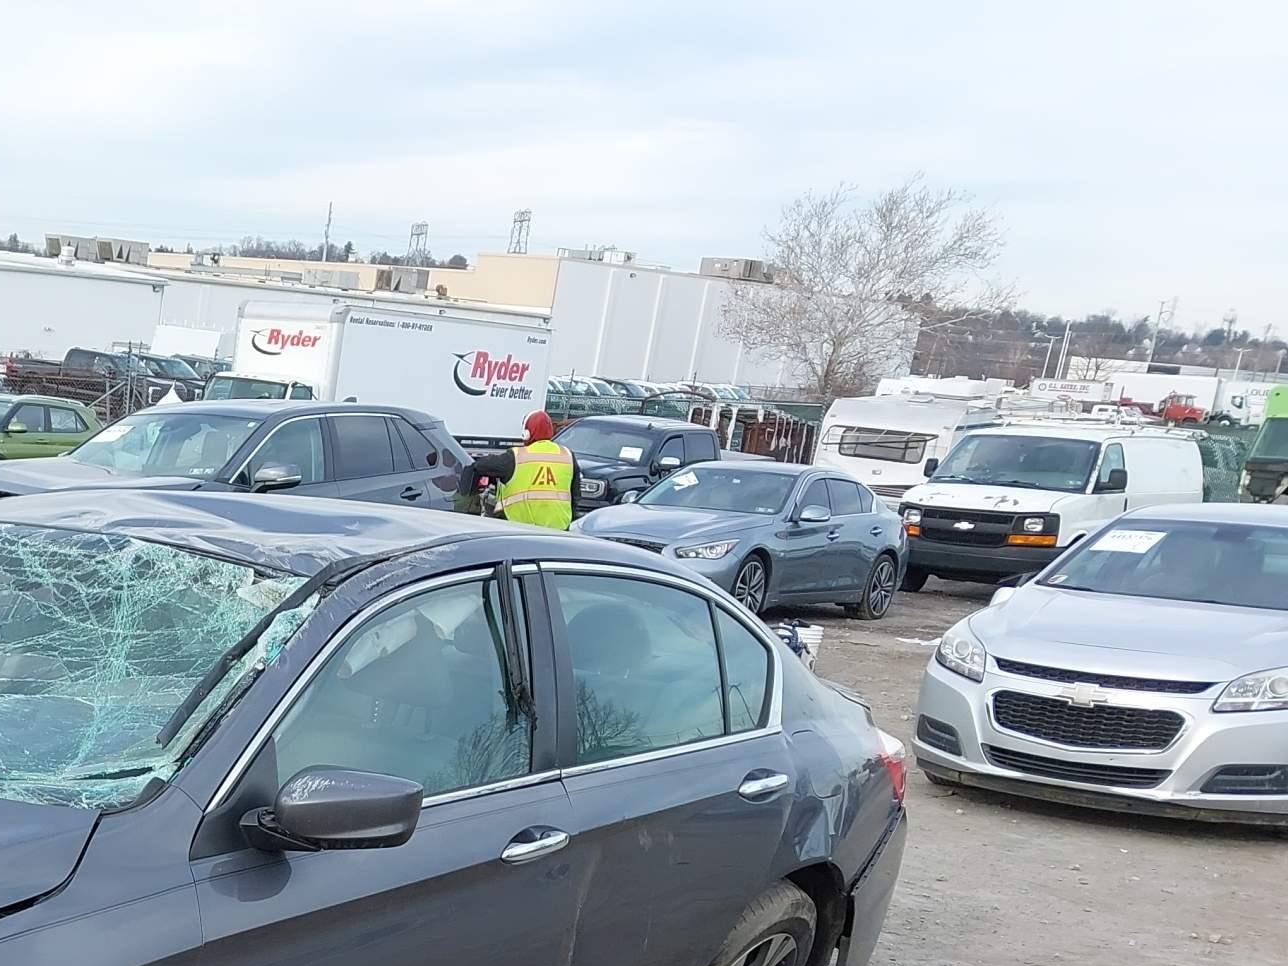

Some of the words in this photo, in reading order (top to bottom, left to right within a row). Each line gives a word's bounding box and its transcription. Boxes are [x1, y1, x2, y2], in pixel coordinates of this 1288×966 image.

[267, 328, 321, 349] Ryder
[471, 350, 529, 386] Ryder
[490, 384, 509, 398] Ever
[509, 384, 533, 400] better.
